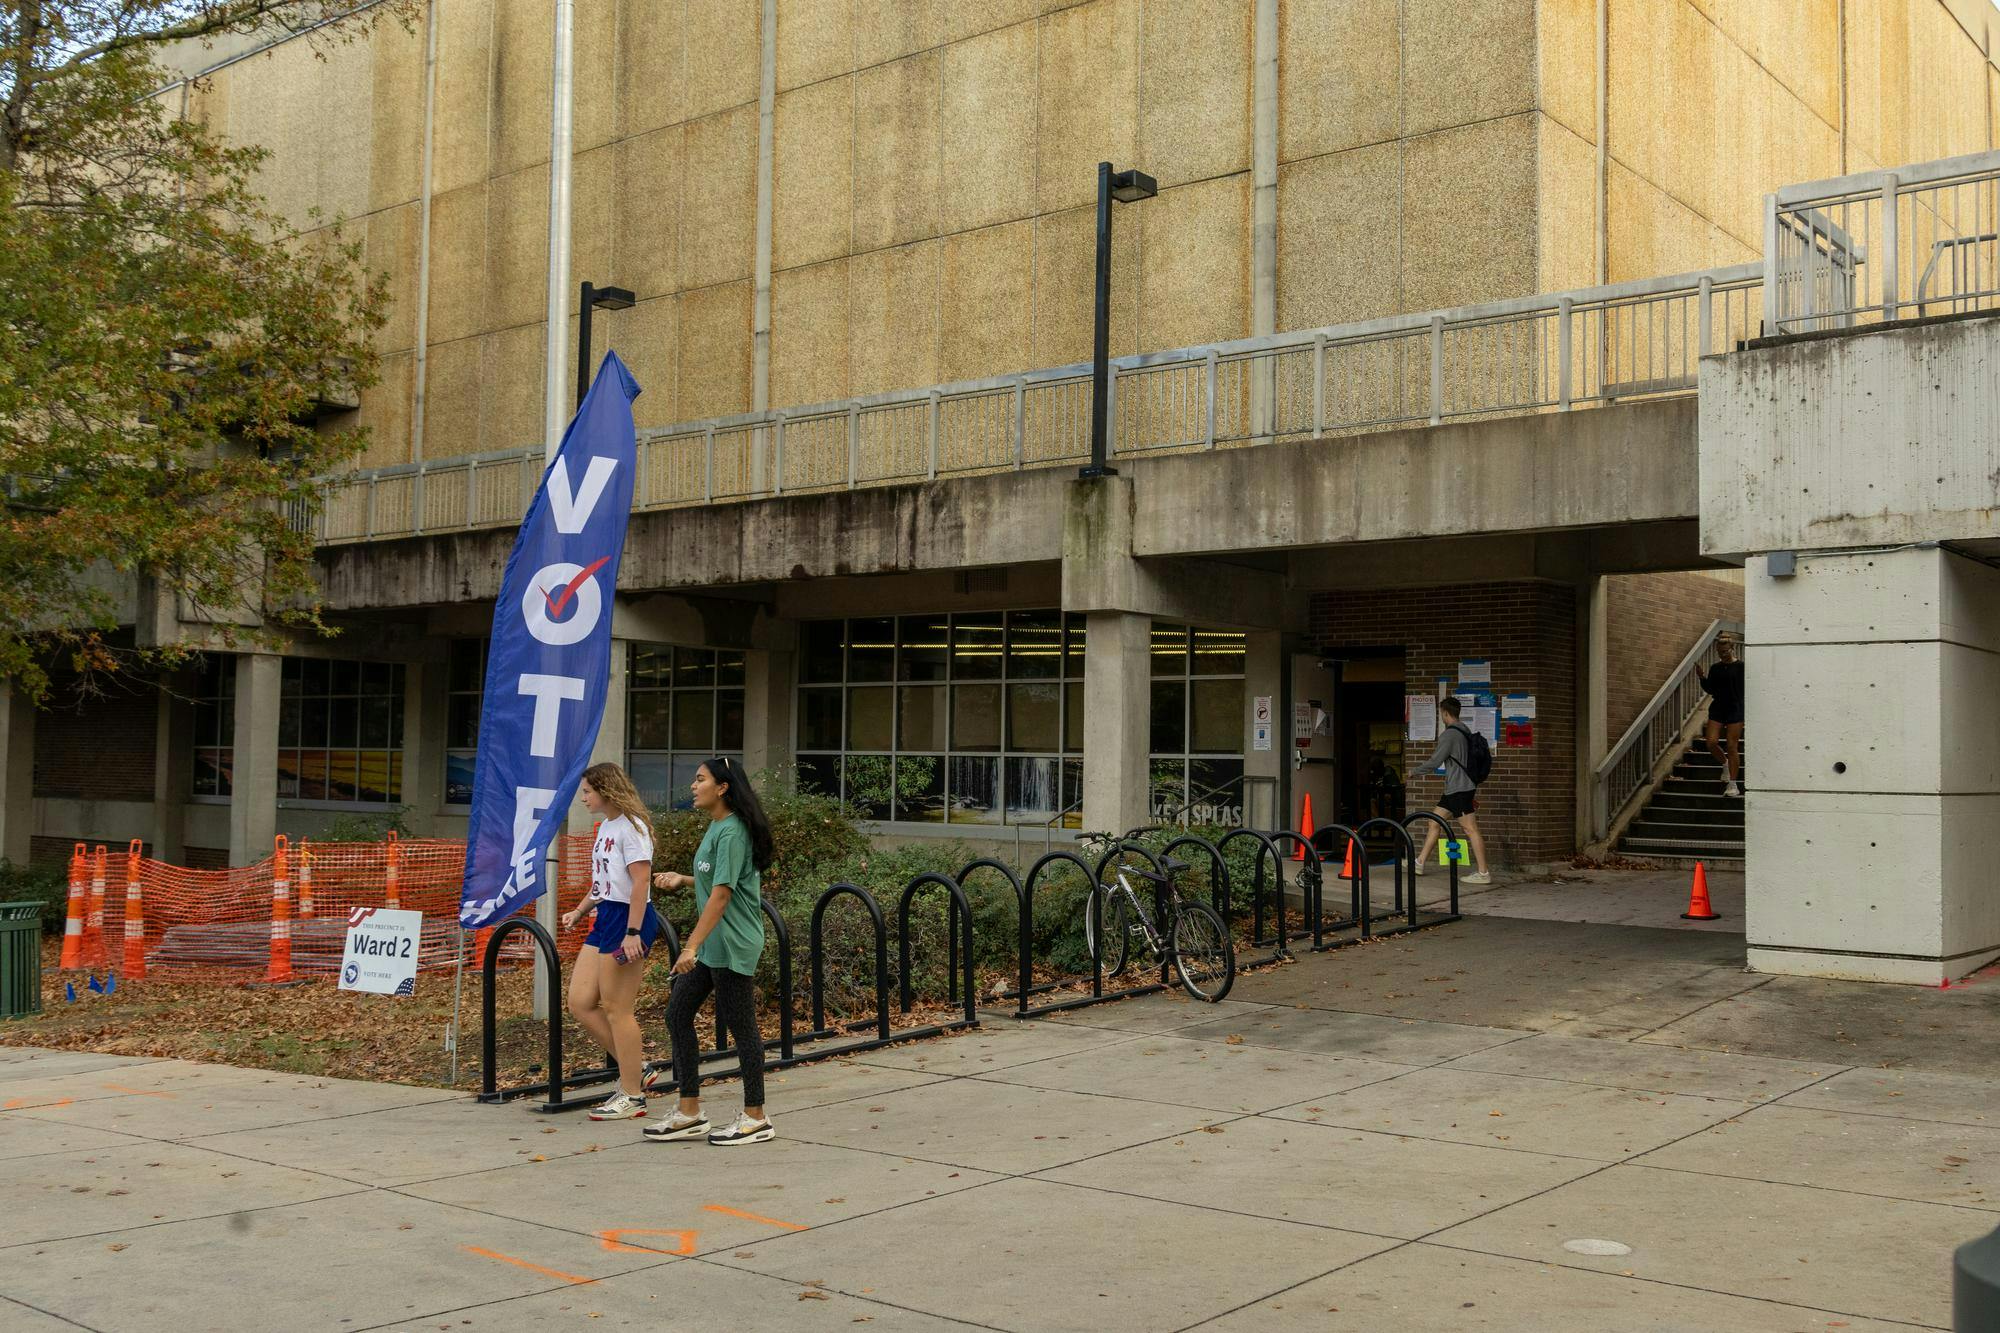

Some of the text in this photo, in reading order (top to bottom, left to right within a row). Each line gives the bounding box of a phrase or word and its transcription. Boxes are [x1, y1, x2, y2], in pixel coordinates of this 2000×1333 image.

[510, 455, 618, 867] VOTE
[1192, 804, 1243, 827] SPLAS
[354, 933, 411, 958] Ward 2
